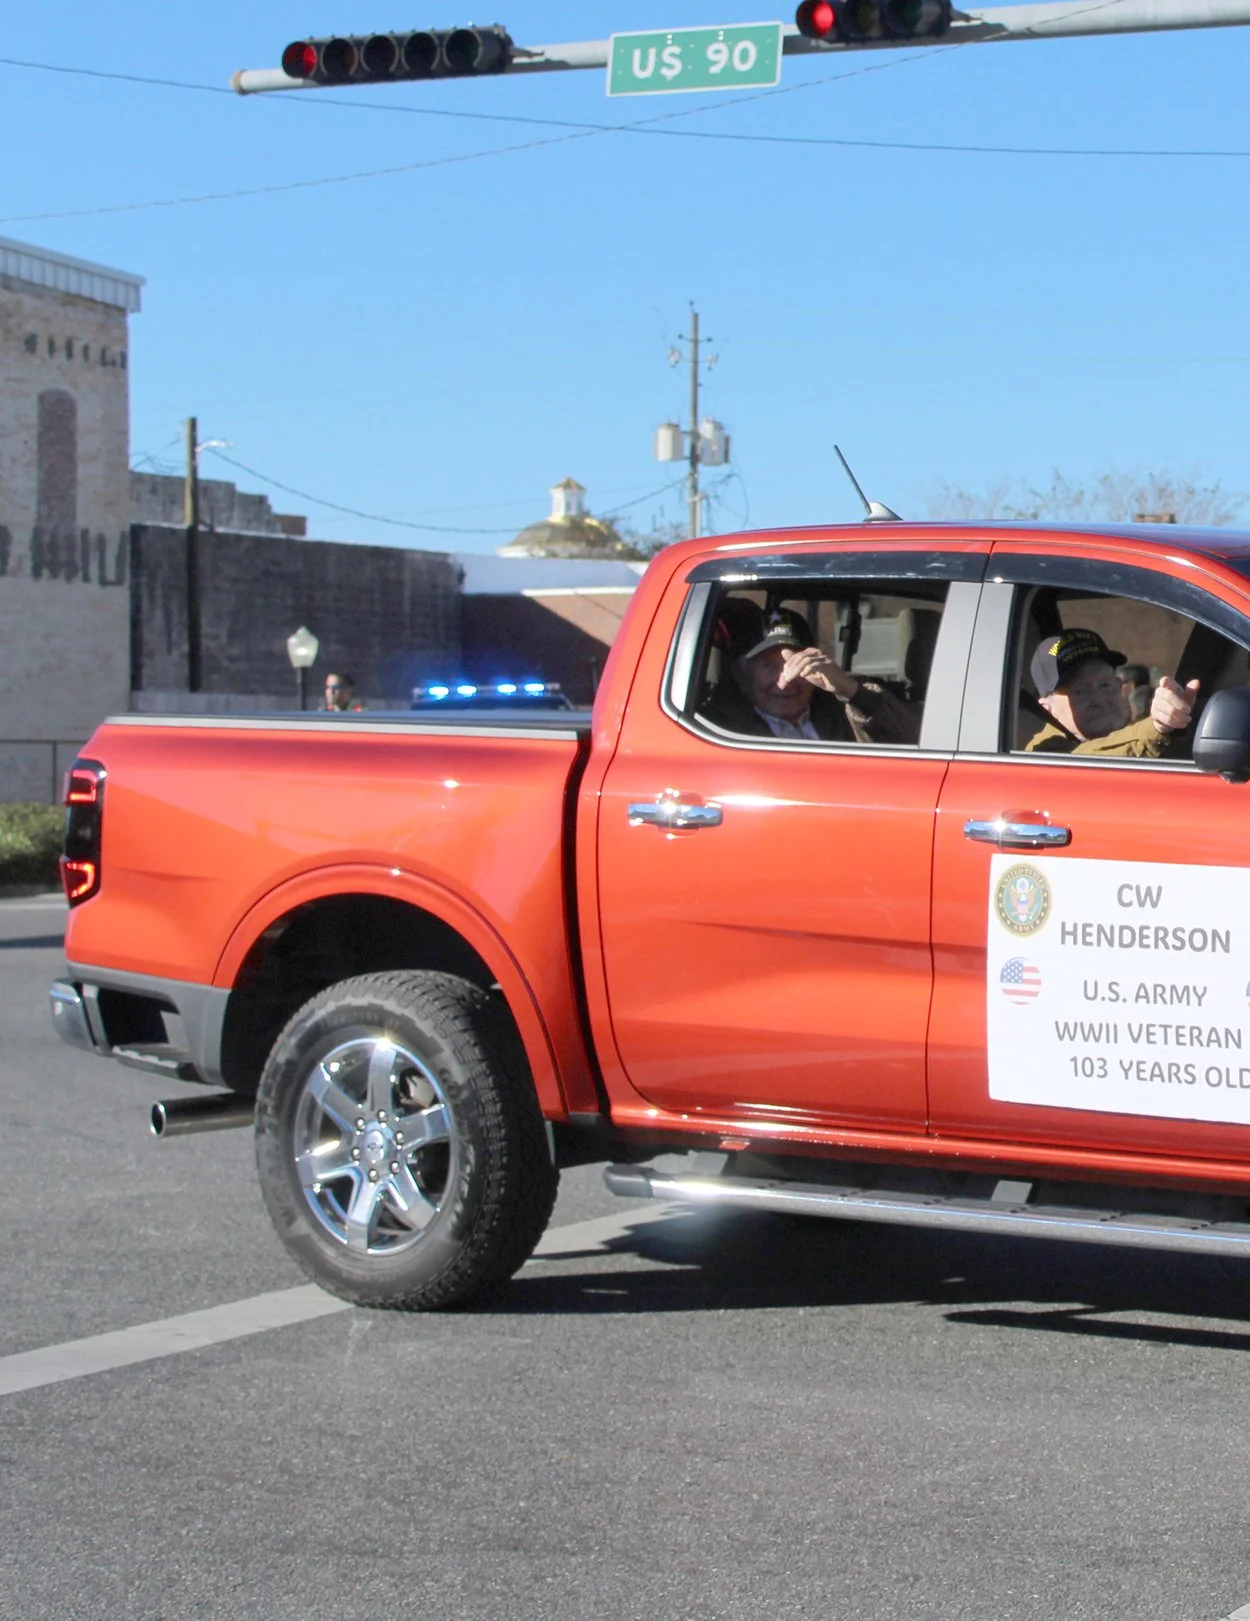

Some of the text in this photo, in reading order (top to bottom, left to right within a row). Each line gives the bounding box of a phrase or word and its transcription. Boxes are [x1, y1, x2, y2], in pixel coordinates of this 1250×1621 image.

[633, 40, 757, 79] US 90
[1117, 883, 1163, 909] CW
[1013, 924, 1035, 933] ARMY
[1060, 921, 1231, 954] HENDERSON
[1083, 979, 1208, 1008] U.S. ARMY
[1054, 1020, 1242, 1050] WWII VETERAN
[1069, 1055, 1109, 1080] 103
[1118, 1059, 1197, 1086] YEARS
